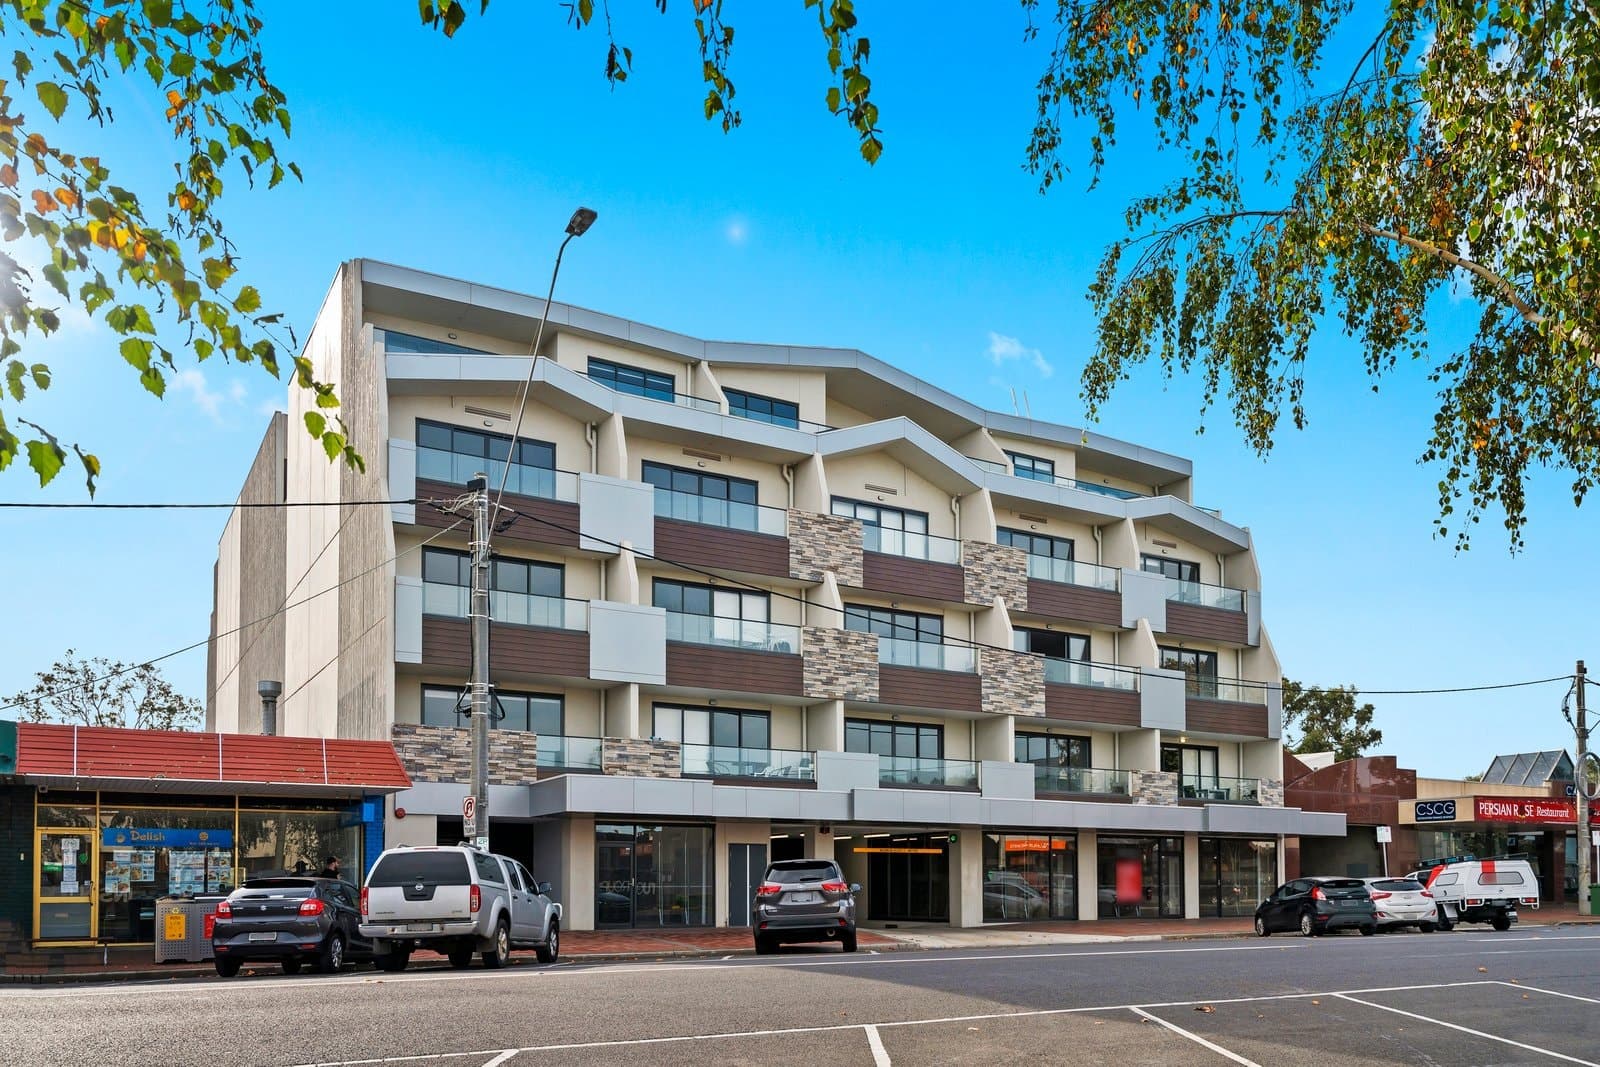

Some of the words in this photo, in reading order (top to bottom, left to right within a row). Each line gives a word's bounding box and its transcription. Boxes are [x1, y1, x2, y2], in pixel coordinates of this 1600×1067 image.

[1416, 802, 1455, 816] CSCG
[1479, 802, 1512, 817] PERSIAN
[1513, 803, 1534, 818] RSE
[1536, 806, 1569, 818] Restaurant
[130, 830, 165, 841] Delish
